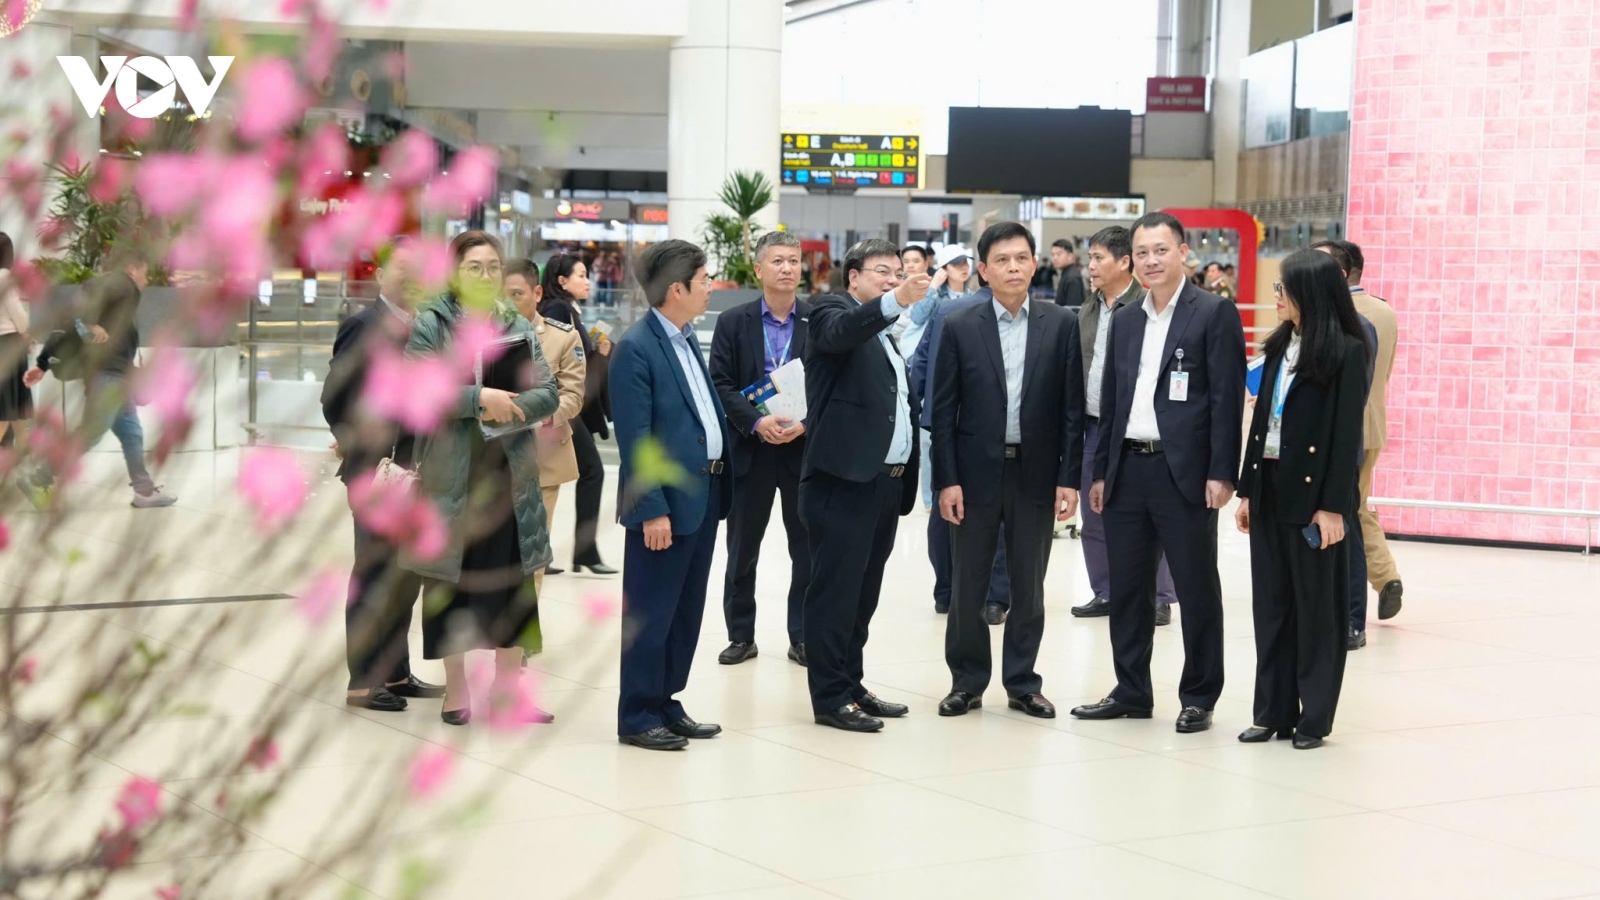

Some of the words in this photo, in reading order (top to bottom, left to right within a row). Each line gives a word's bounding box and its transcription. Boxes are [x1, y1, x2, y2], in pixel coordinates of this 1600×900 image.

[810, 136, 821, 148] E
[880, 137, 892, 149] A
[830, 153, 855, 168] A,B
